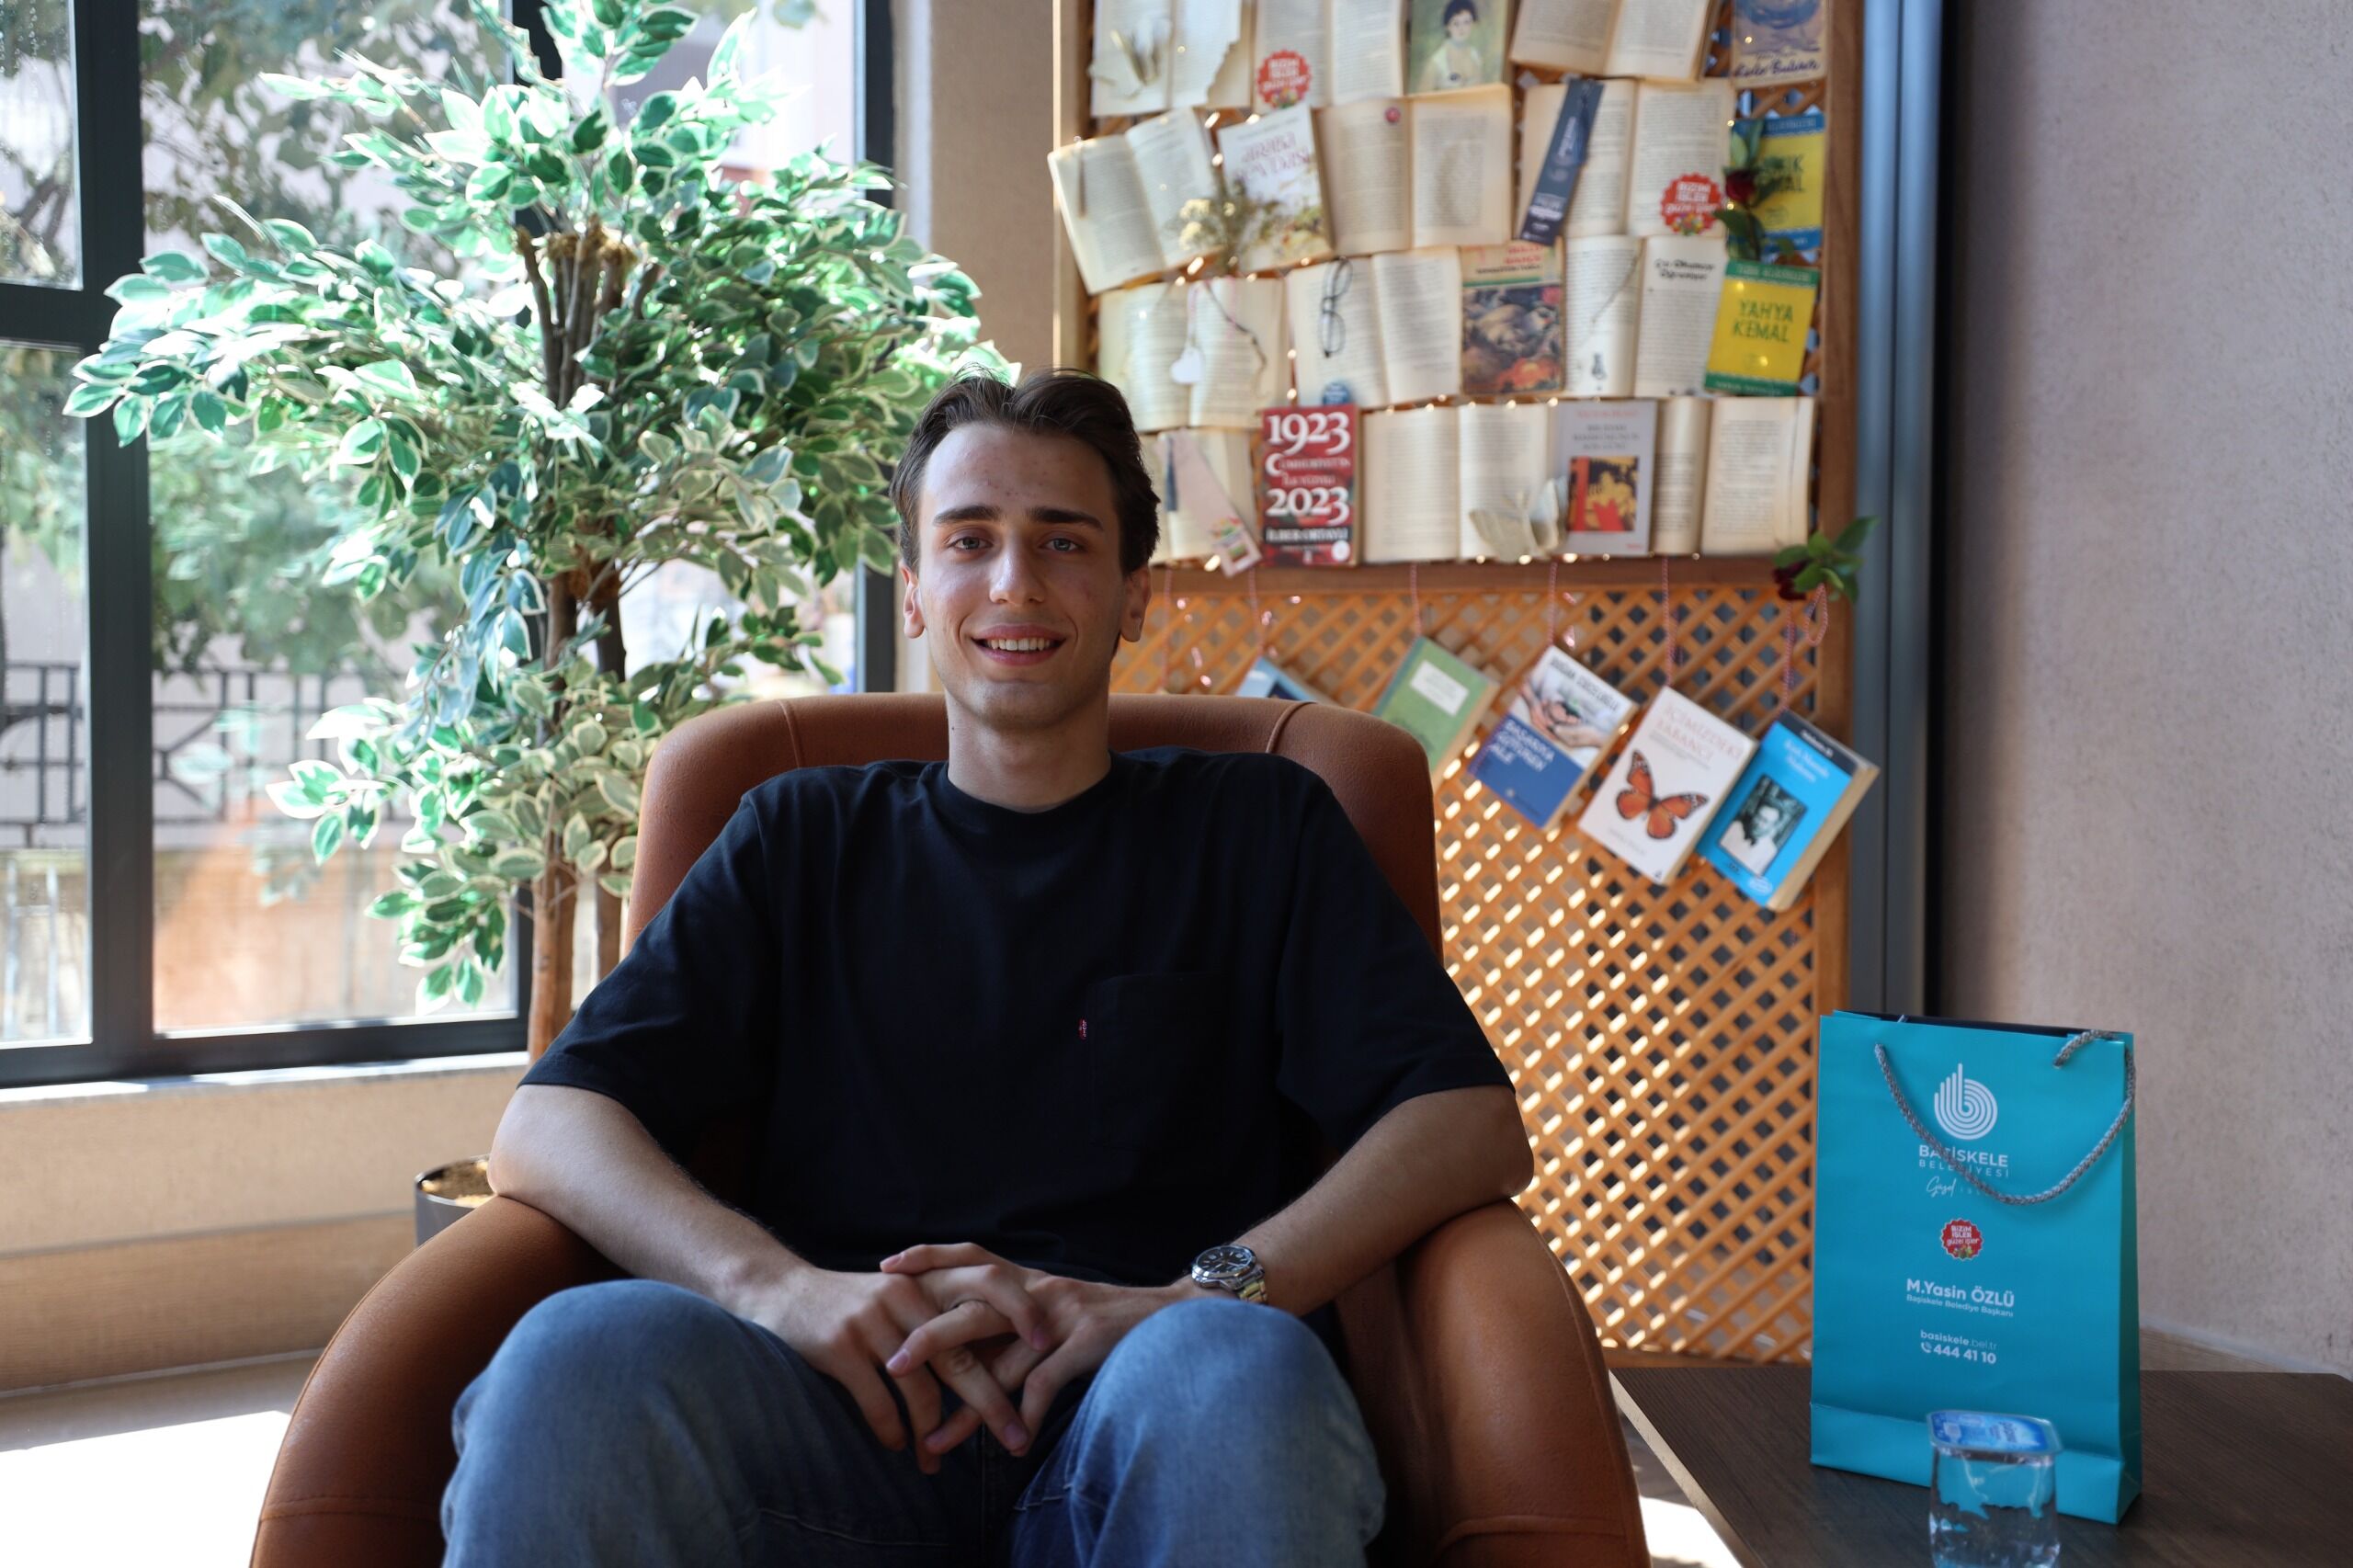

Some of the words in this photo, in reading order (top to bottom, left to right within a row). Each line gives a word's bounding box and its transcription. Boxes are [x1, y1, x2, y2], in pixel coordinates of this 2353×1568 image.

[1739, 300, 1794, 323] YAHYA
[1733, 320, 1790, 343] KEMAL
[1267, 412, 1351, 457] 1923
[1267, 486, 1350, 526] 2023
[1919, 1144, 2008, 1167] BAİSKELE
[1906, 1278, 1966, 1300] M.Yasin
[1971, 1286, 2015, 1307] ÖZLÜ
[1945, 1301, 1979, 1312] Belediye
[1934, 1344, 1961, 1358] 444
[1963, 1348, 1978, 1361] 41
[1981, 1352, 1996, 1364] 10
